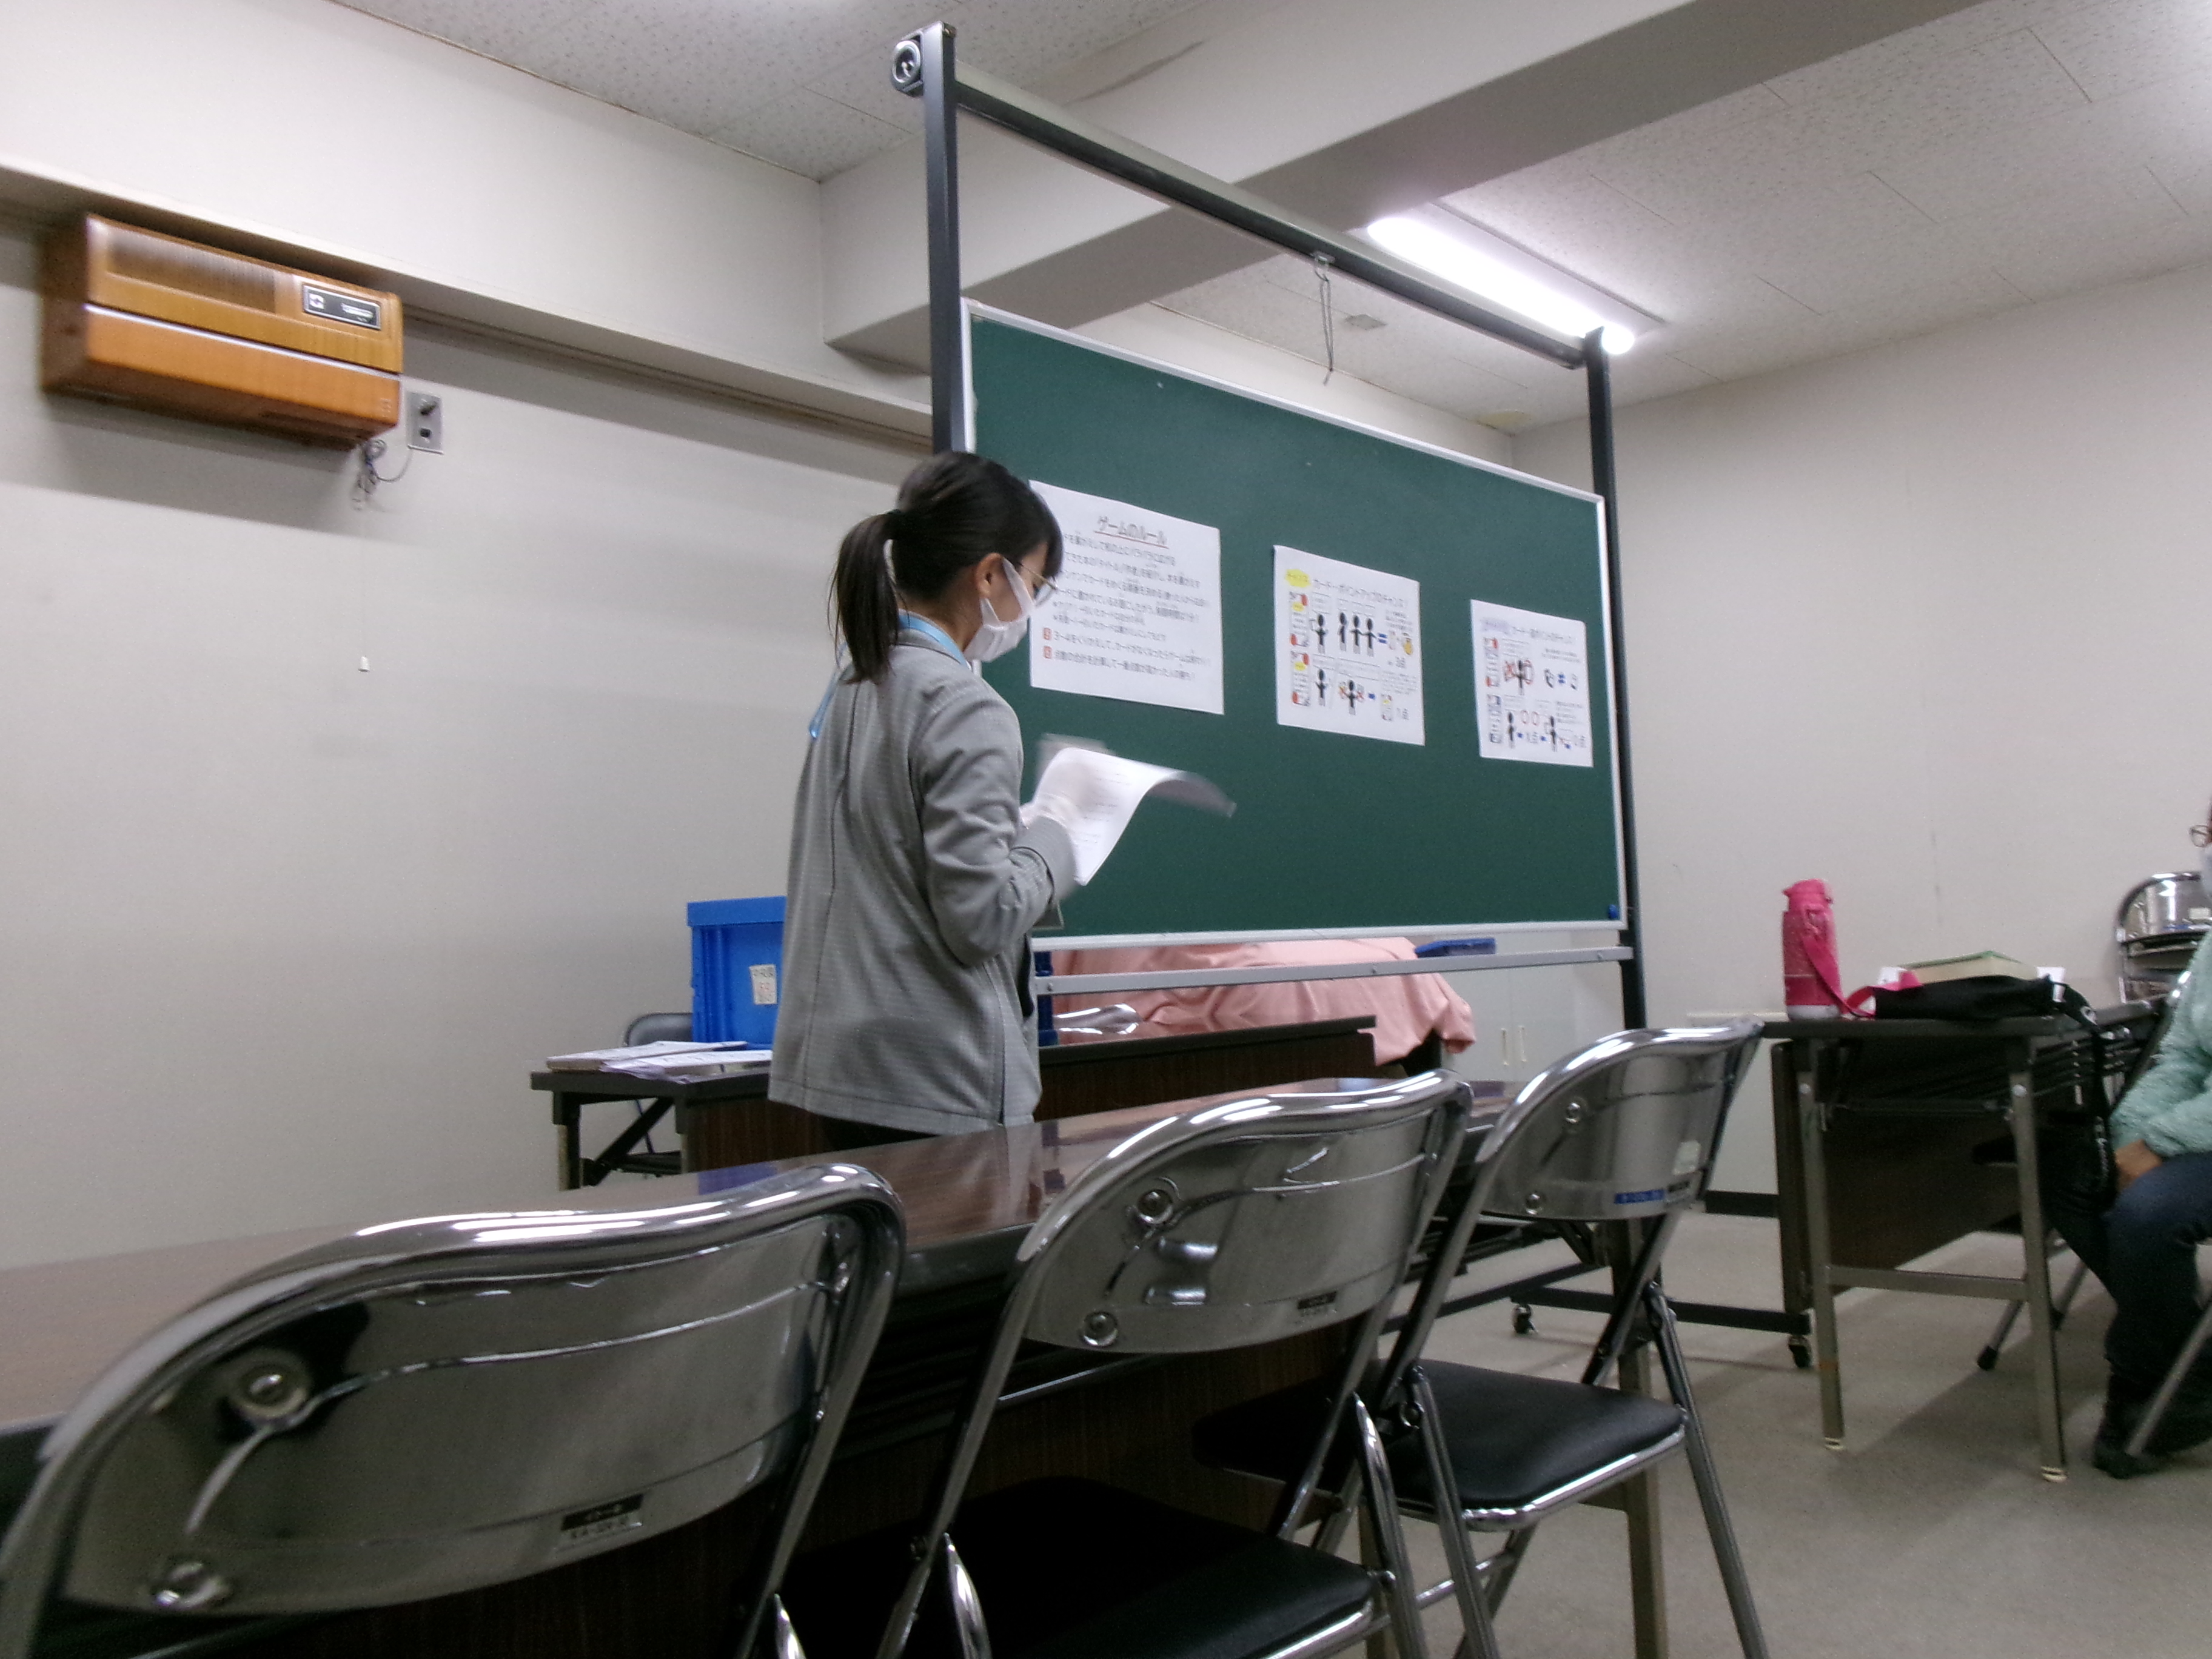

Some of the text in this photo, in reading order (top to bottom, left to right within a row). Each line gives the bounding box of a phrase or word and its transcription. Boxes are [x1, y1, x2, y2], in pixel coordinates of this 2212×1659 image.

[1097, 515, 1168, 545] ゲームのルール
